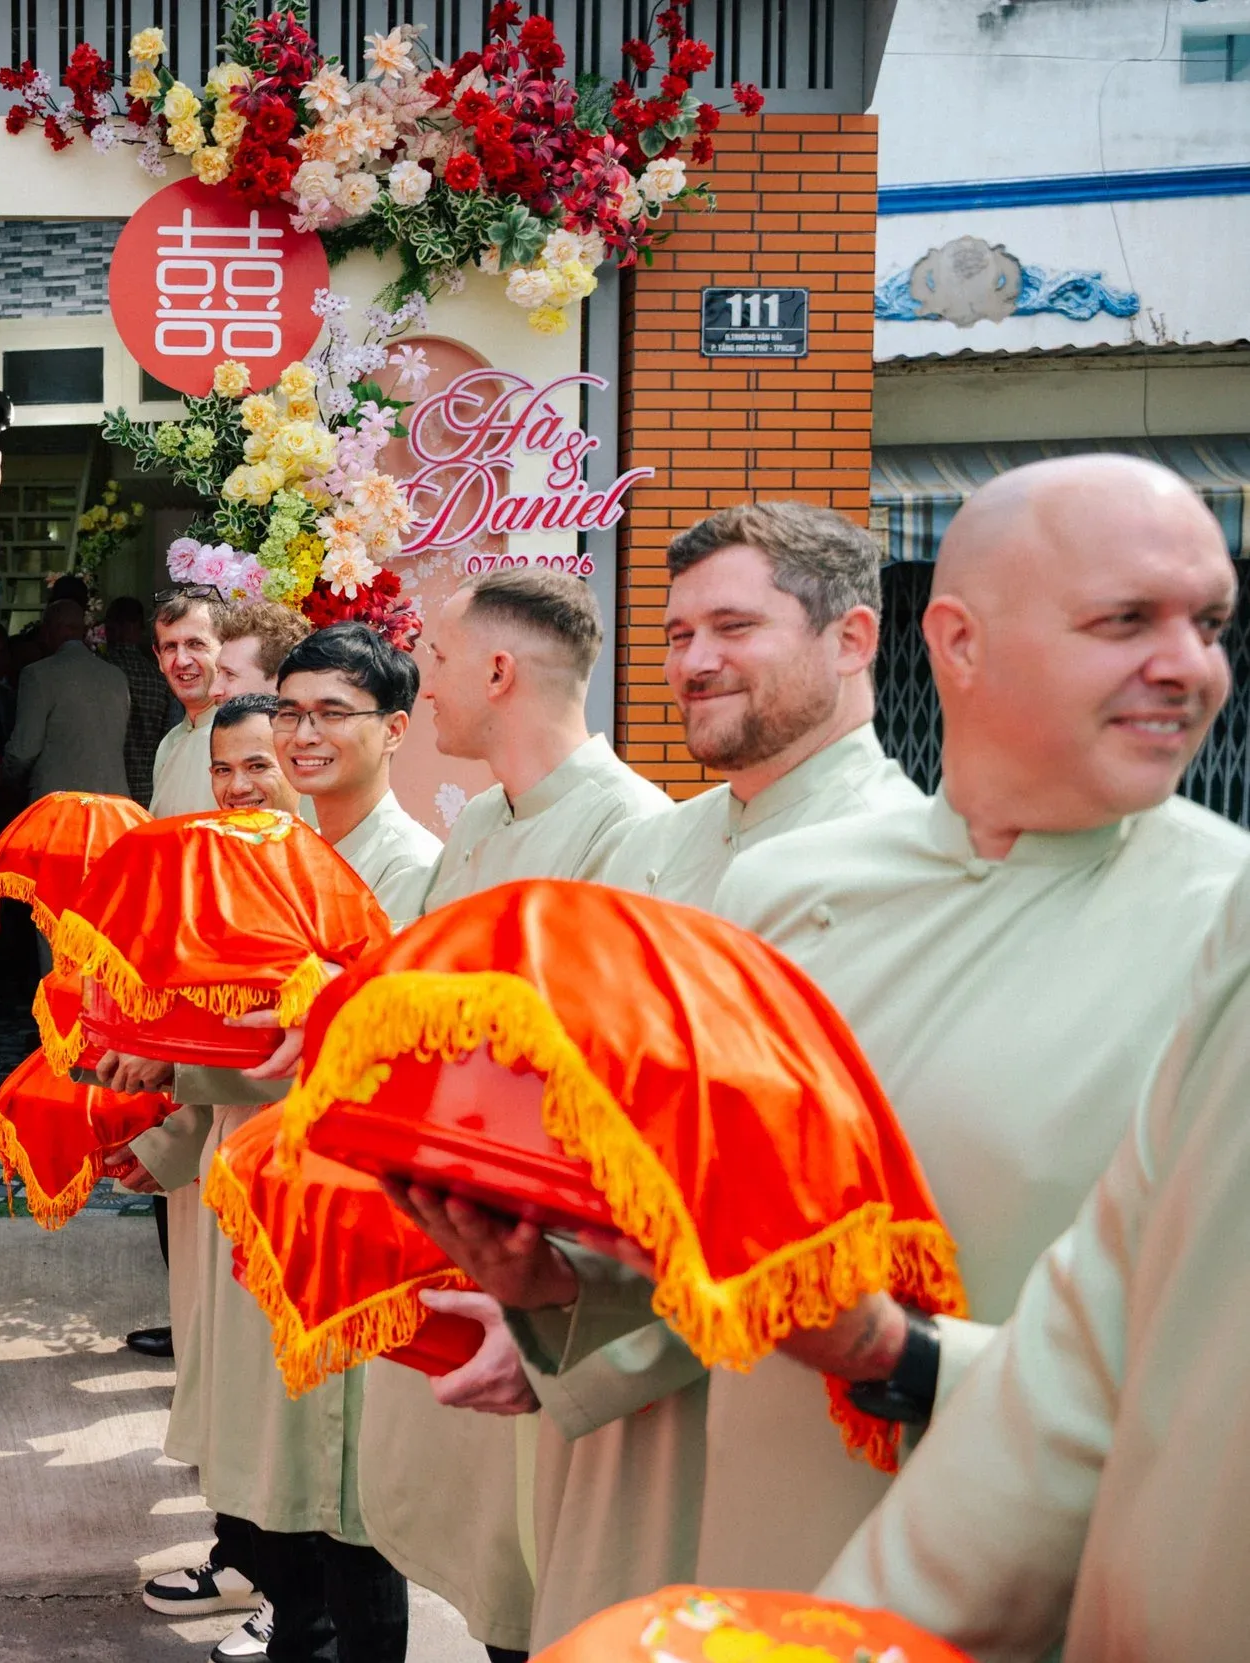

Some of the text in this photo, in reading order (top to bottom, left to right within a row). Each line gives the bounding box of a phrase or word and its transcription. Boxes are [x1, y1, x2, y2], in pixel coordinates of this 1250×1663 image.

[155, 208, 284, 357] 囍
[726, 294, 779, 327] 111
[410, 370, 607, 464] Hà
[548, 430, 602, 491] &
[397, 459, 655, 553] Daniel
